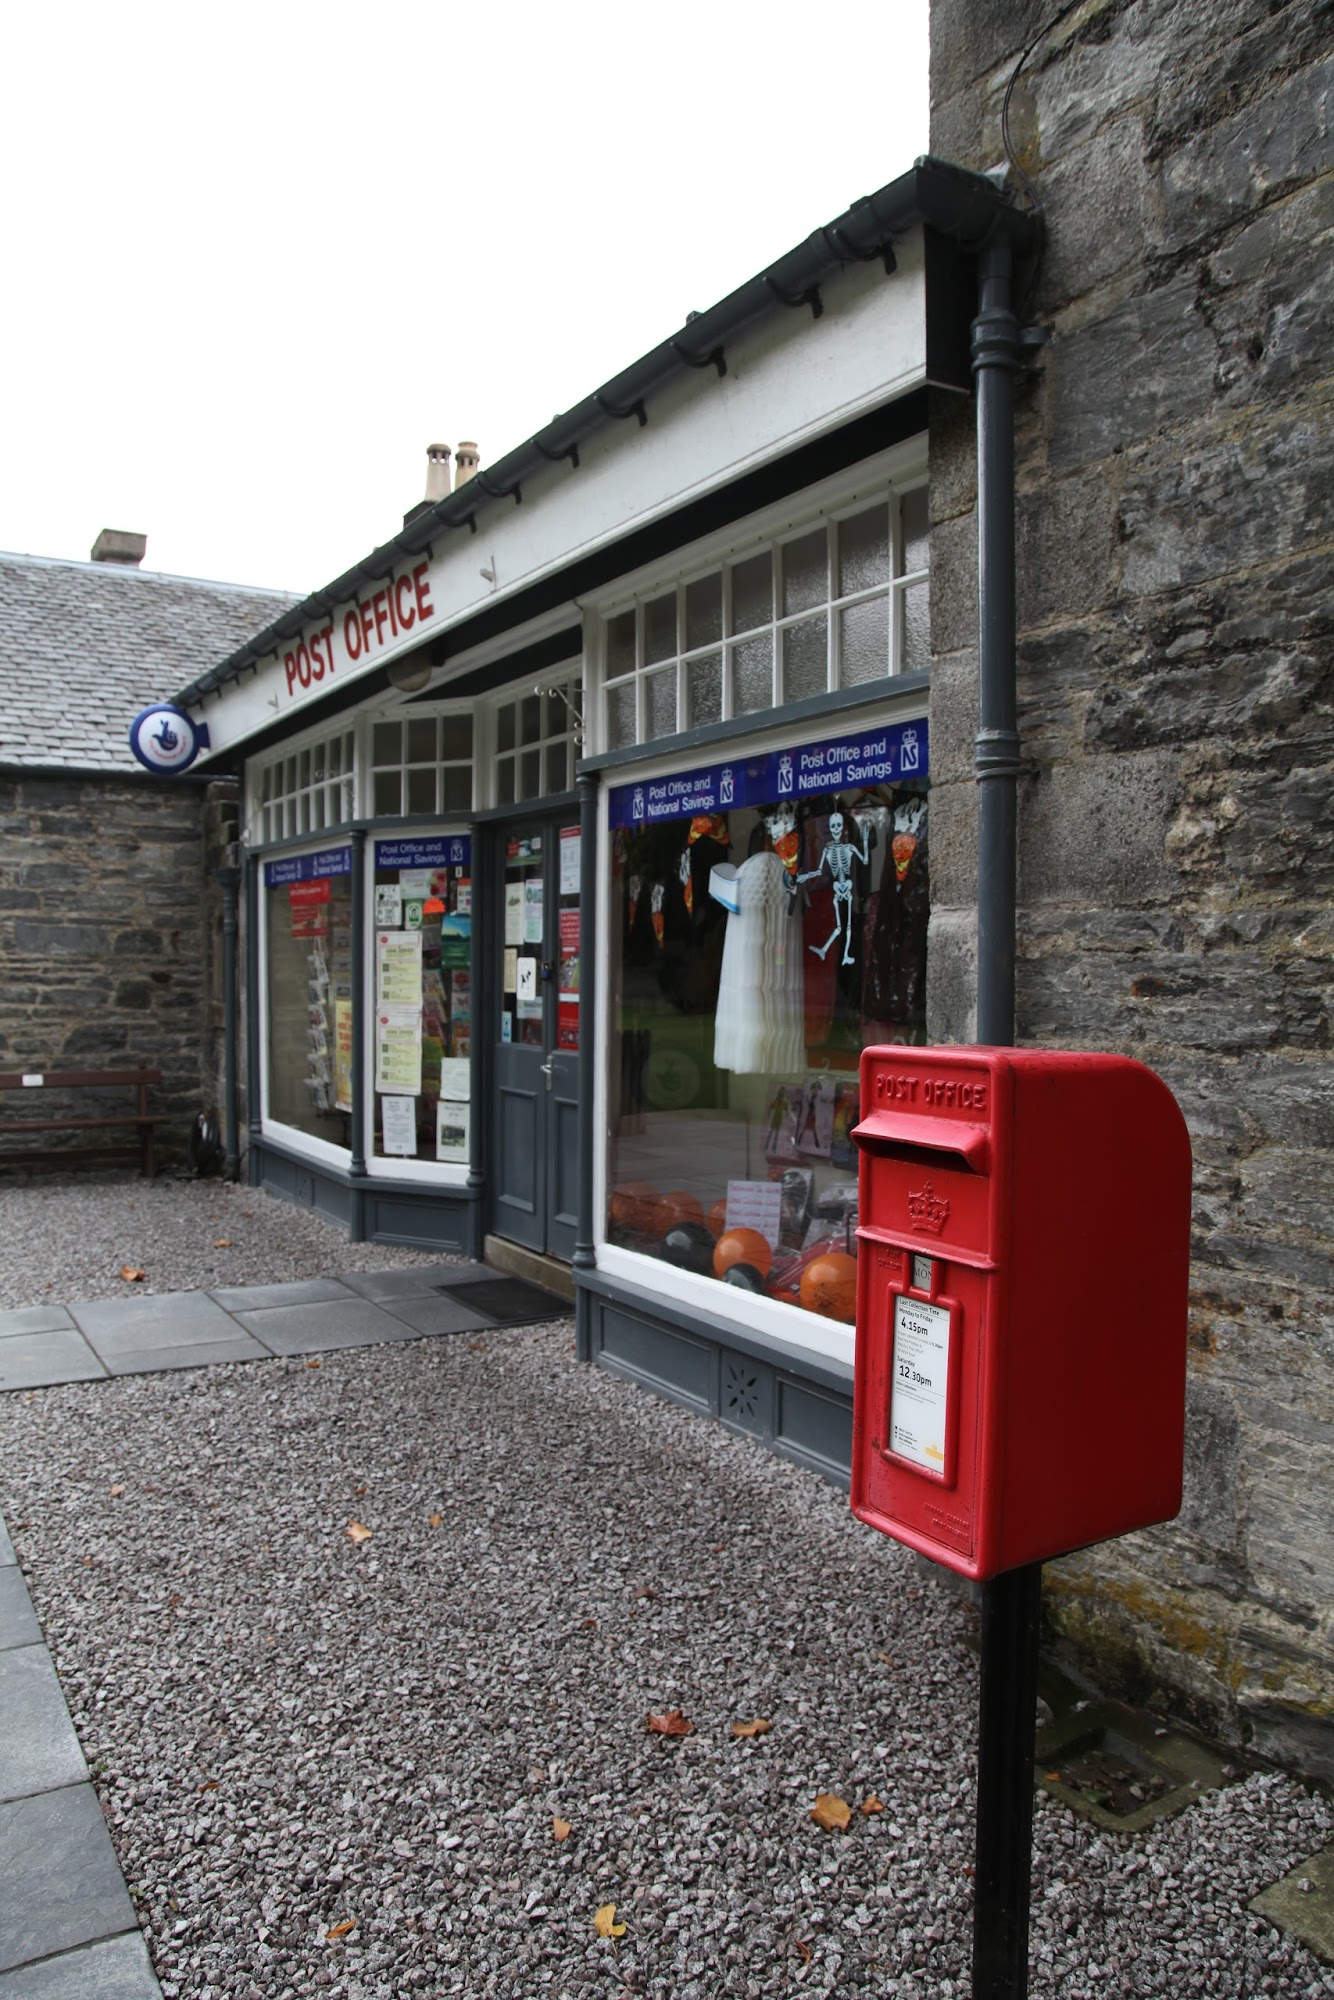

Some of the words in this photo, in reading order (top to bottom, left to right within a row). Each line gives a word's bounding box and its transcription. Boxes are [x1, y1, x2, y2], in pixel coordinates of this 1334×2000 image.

[284, 624, 334, 696] POST
[344, 561, 434, 660] OFFICE
[801, 754, 824, 770] Post
[827, 746, 860, 765] Office
[863, 738, 886, 757] and
[799, 768, 842, 790] National
[847, 762, 892, 782] Savings
[650, 786, 666, 800] Post
[668, 782, 692, 796] Office
[694, 775, 711, 790] and
[648, 799, 679, 817] National
[682, 794, 715, 811] Savings
[380, 845, 398, 854] Post
[400, 843, 423, 853] Office
[425, 842, 442, 851] and
[379, 855, 411, 865] National
[414, 854, 446, 864] Savings
[876, 1074, 918, 1102] POST
[924, 1079, 986, 1109] OFFICE
[899, 1299, 908, 1307] Last
[909, 1301, 928, 1312] Collection
[929, 1308, 939, 1316] Time
[899, 1307, 915, 1318] Monday
[920, 1313, 933, 1324] Friday
[901, 1317, 928, 1336] 4.15pm
[897, 1355, 915, 1367] Saturday
[899, 1365, 932, 1387] 12.30pm
